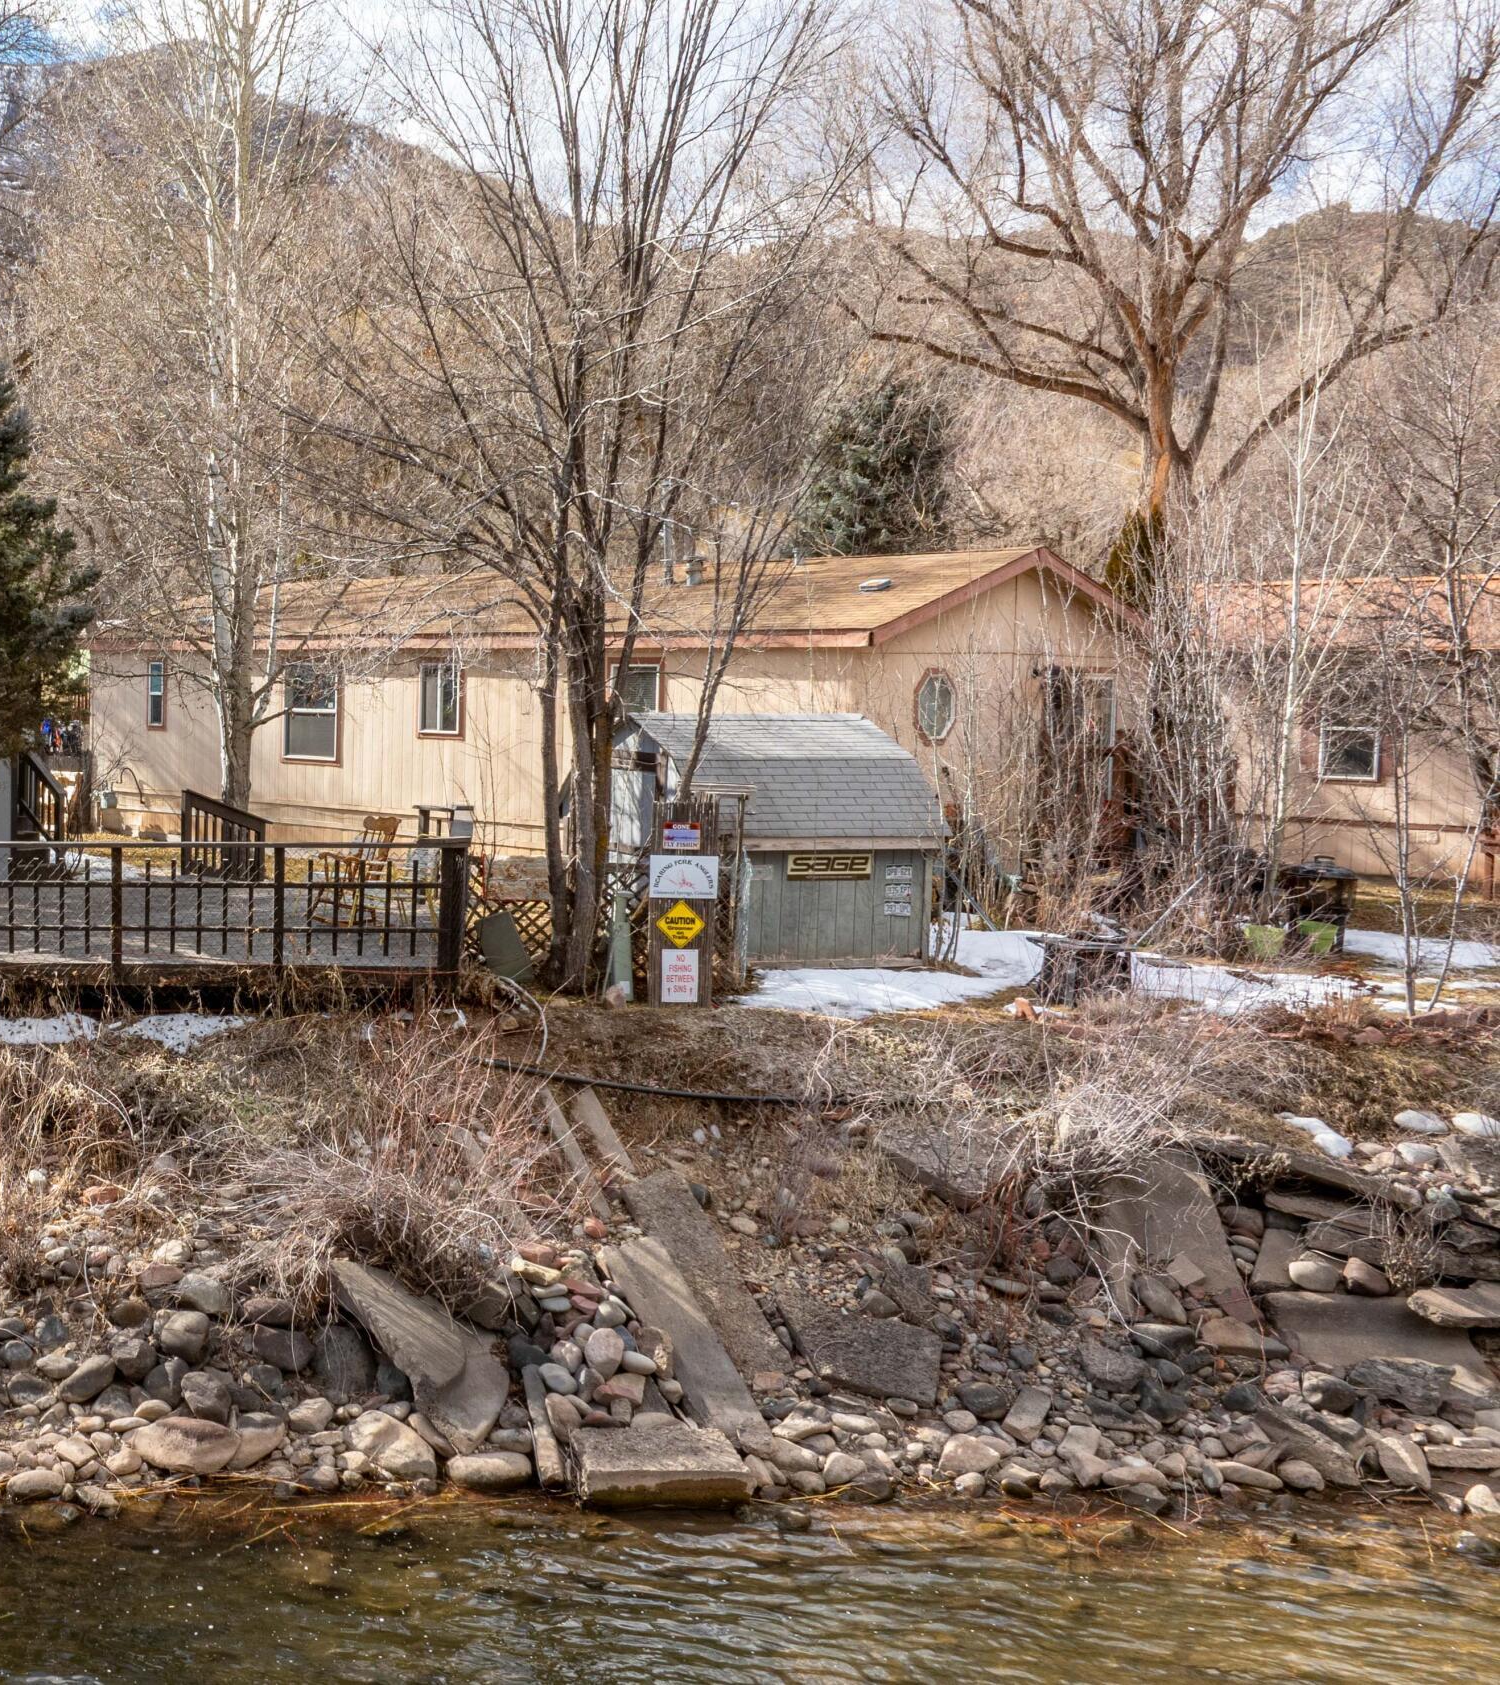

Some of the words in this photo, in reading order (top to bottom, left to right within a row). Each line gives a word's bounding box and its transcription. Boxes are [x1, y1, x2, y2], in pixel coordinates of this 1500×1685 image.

[665, 916, 696, 925] CAUTION
[676, 954, 686, 962] NO
[669, 964, 693, 972] FISHING
[665, 974, 695, 983] BETWEEN
